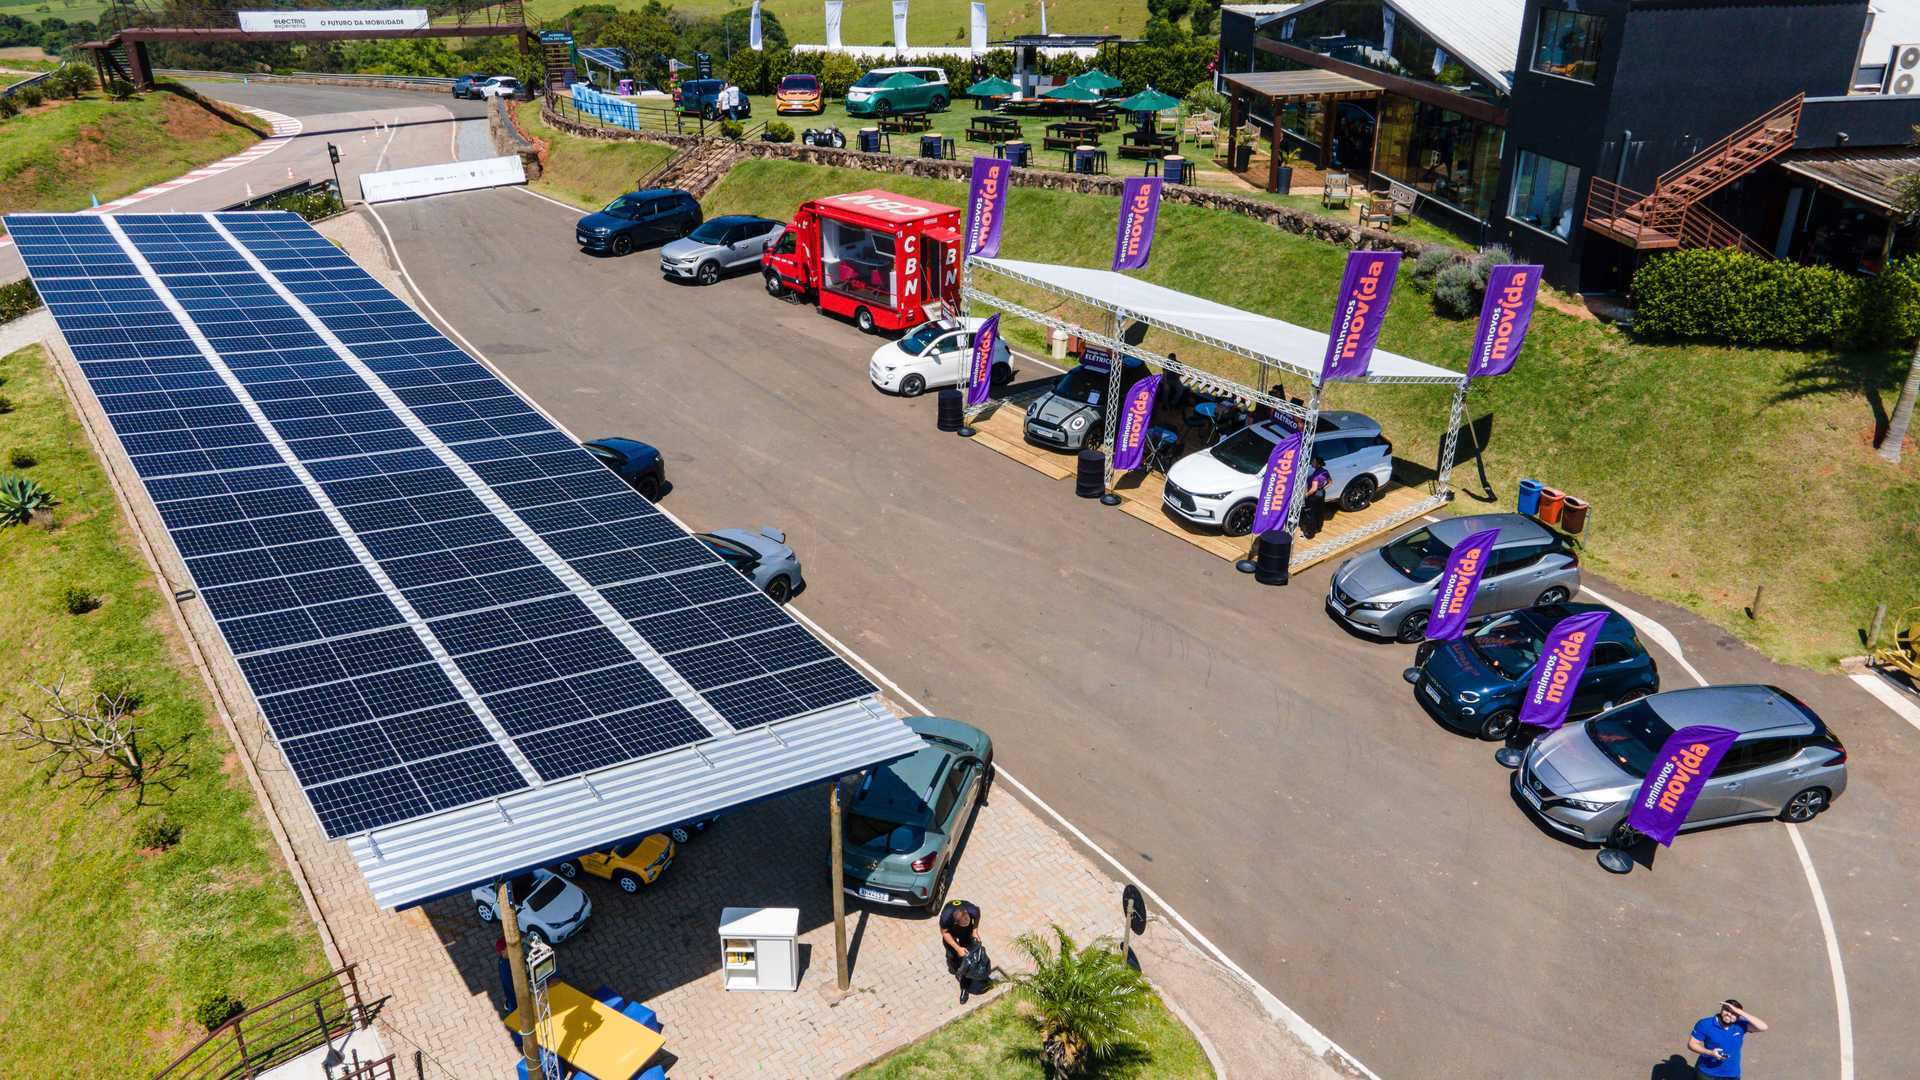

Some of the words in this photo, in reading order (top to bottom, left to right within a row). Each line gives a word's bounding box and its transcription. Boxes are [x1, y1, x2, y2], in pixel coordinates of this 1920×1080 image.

[904, 235, 918, 297] CBN
[1331, 299, 1356, 368] seminovos
[1480, 307, 1502, 368] seminovos
[1437, 574, 1458, 619] seminovos
[1533, 655, 1558, 705] seminovos
[1644, 761, 1675, 810] seminovos
